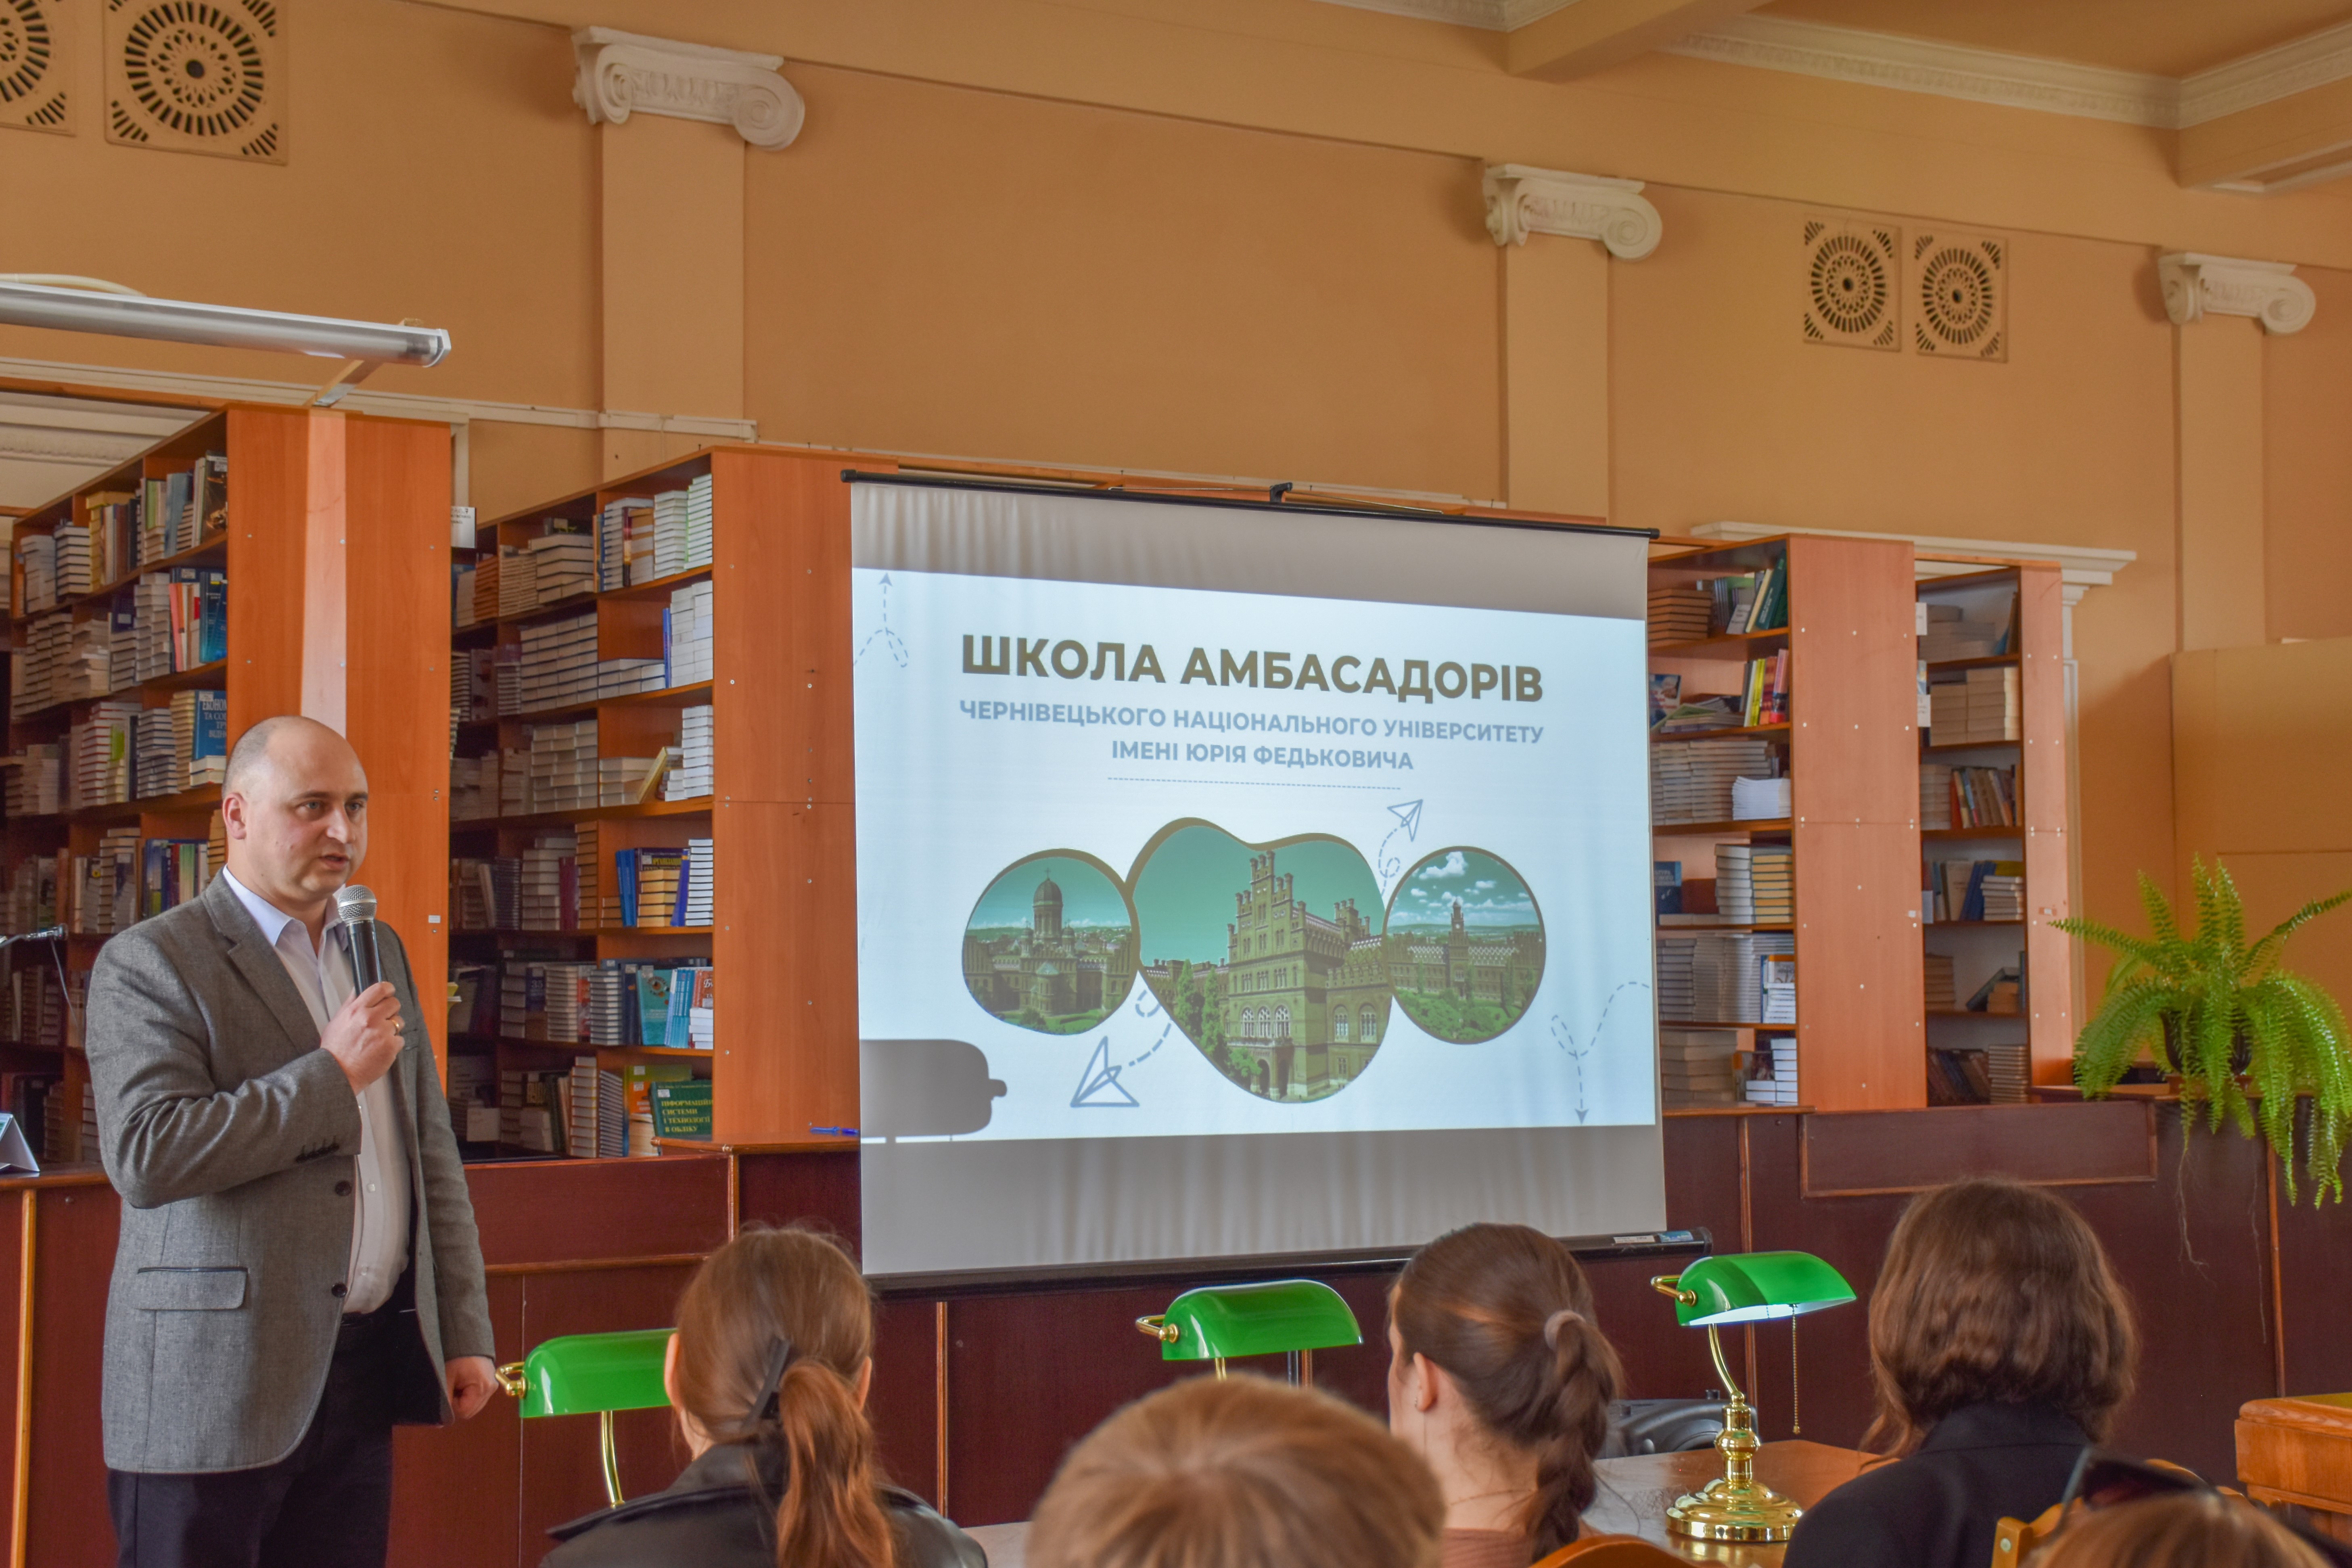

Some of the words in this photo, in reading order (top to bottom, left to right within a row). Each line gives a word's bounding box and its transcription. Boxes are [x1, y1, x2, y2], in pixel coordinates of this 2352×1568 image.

[962, 634, 1166, 683] ШКОЛА
[1179, 647, 1543, 704] АМБАСАДОРІВ
[960, 700, 1166, 727] ЧЕРНІВЕЦЬКОГО
[1174, 710, 1378, 736] НАЦІОНАЛЬНОГО
[1383, 719, 1544, 744] УНІВЕРСИТЕТУ
[1112, 740, 1178, 761] ІМЕНІ
[1186, 744, 1246, 763] ЮРІЯ
[1253, 745, 1414, 769] ФЕДЬКОВИЧА
